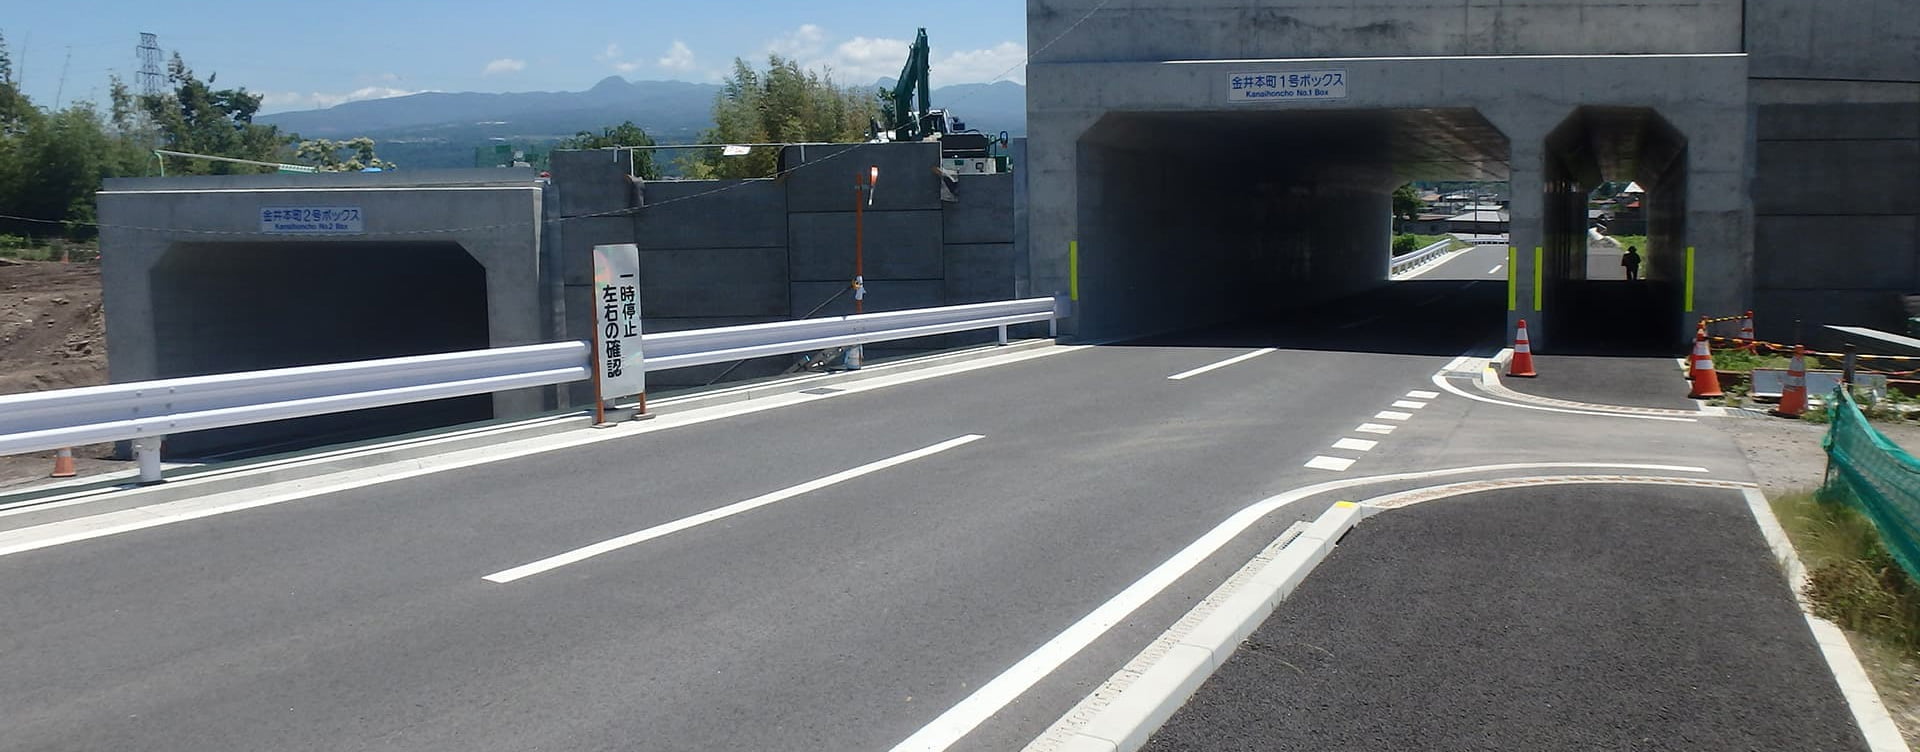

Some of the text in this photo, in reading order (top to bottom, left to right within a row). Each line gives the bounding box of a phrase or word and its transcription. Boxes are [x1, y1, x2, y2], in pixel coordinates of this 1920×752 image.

[602, 284, 622, 378] 左右の確認
[619, 273, 637, 338] 一時停止
